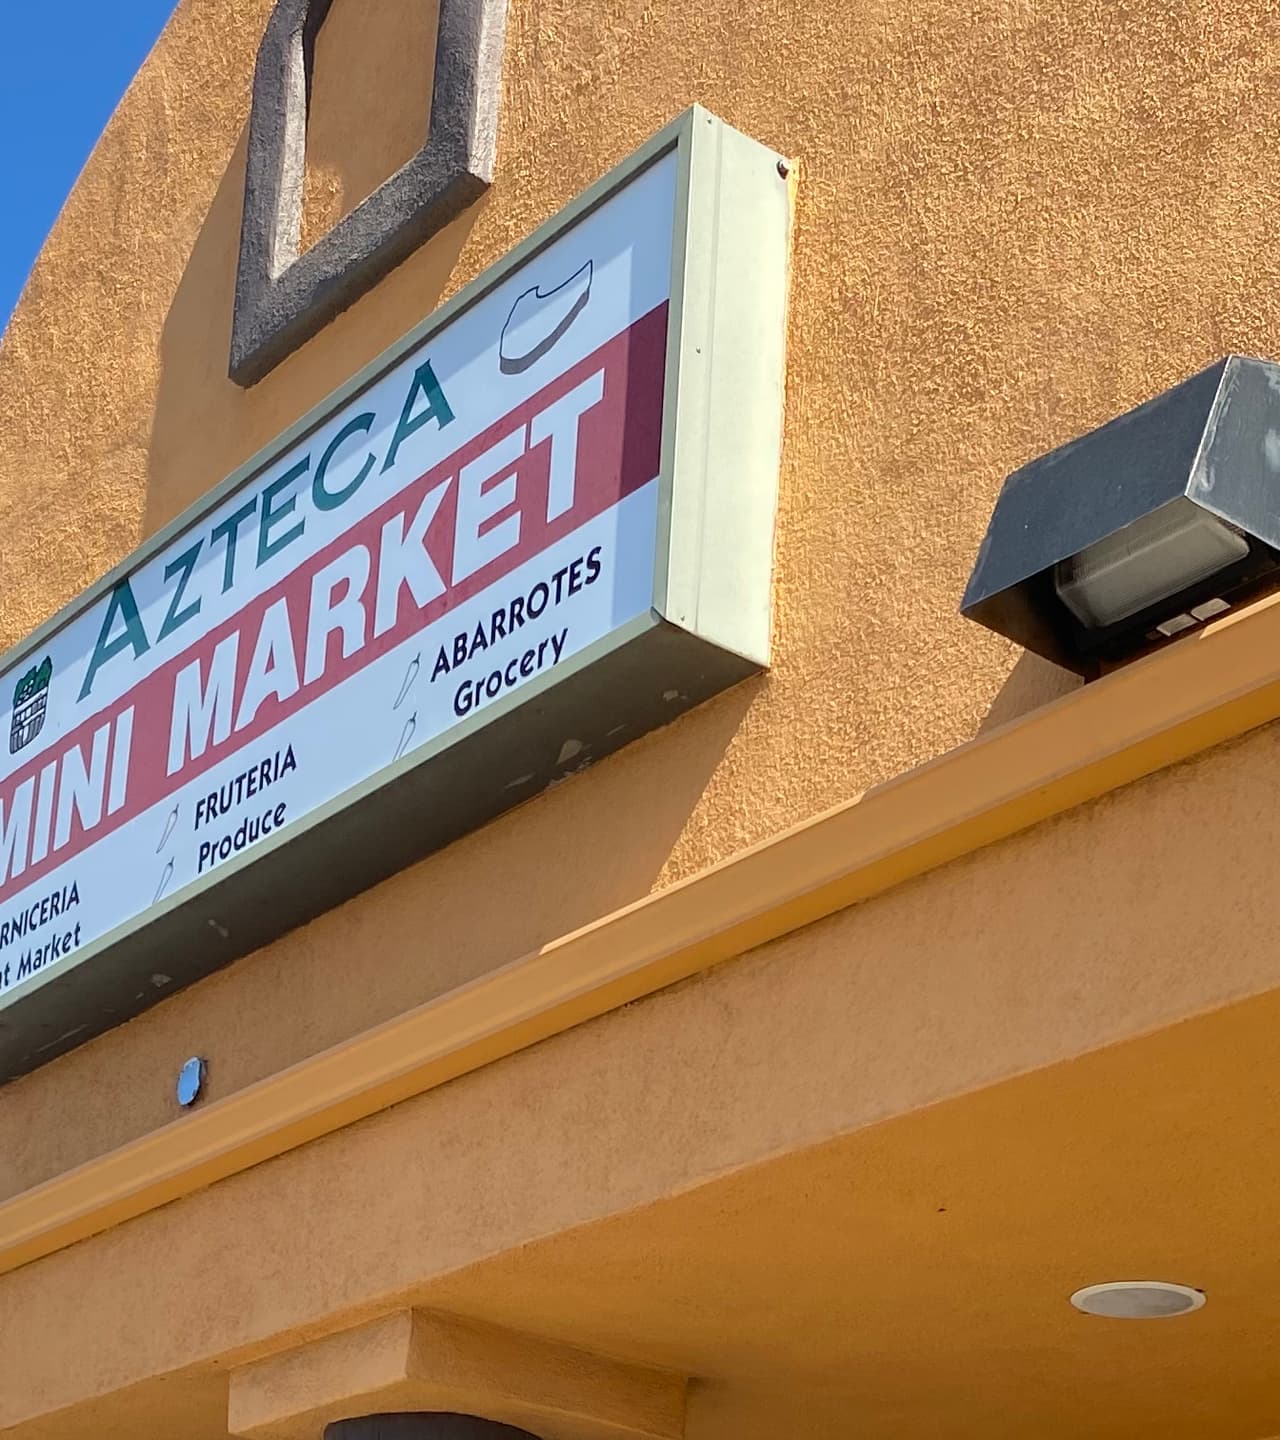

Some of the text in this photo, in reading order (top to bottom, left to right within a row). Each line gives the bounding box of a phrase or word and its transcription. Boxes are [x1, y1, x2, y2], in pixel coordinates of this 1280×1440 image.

[76, 358, 457, 703] AZTECA
[167, 368, 605, 778] MARKET
[430, 547, 603, 683] ABARROTES
[452, 627, 569, 718] Grocery
[194, 744, 298, 831] FRUTERIA
[197, 803, 287, 875] Produce
[16, 923, 82, 981] Market
